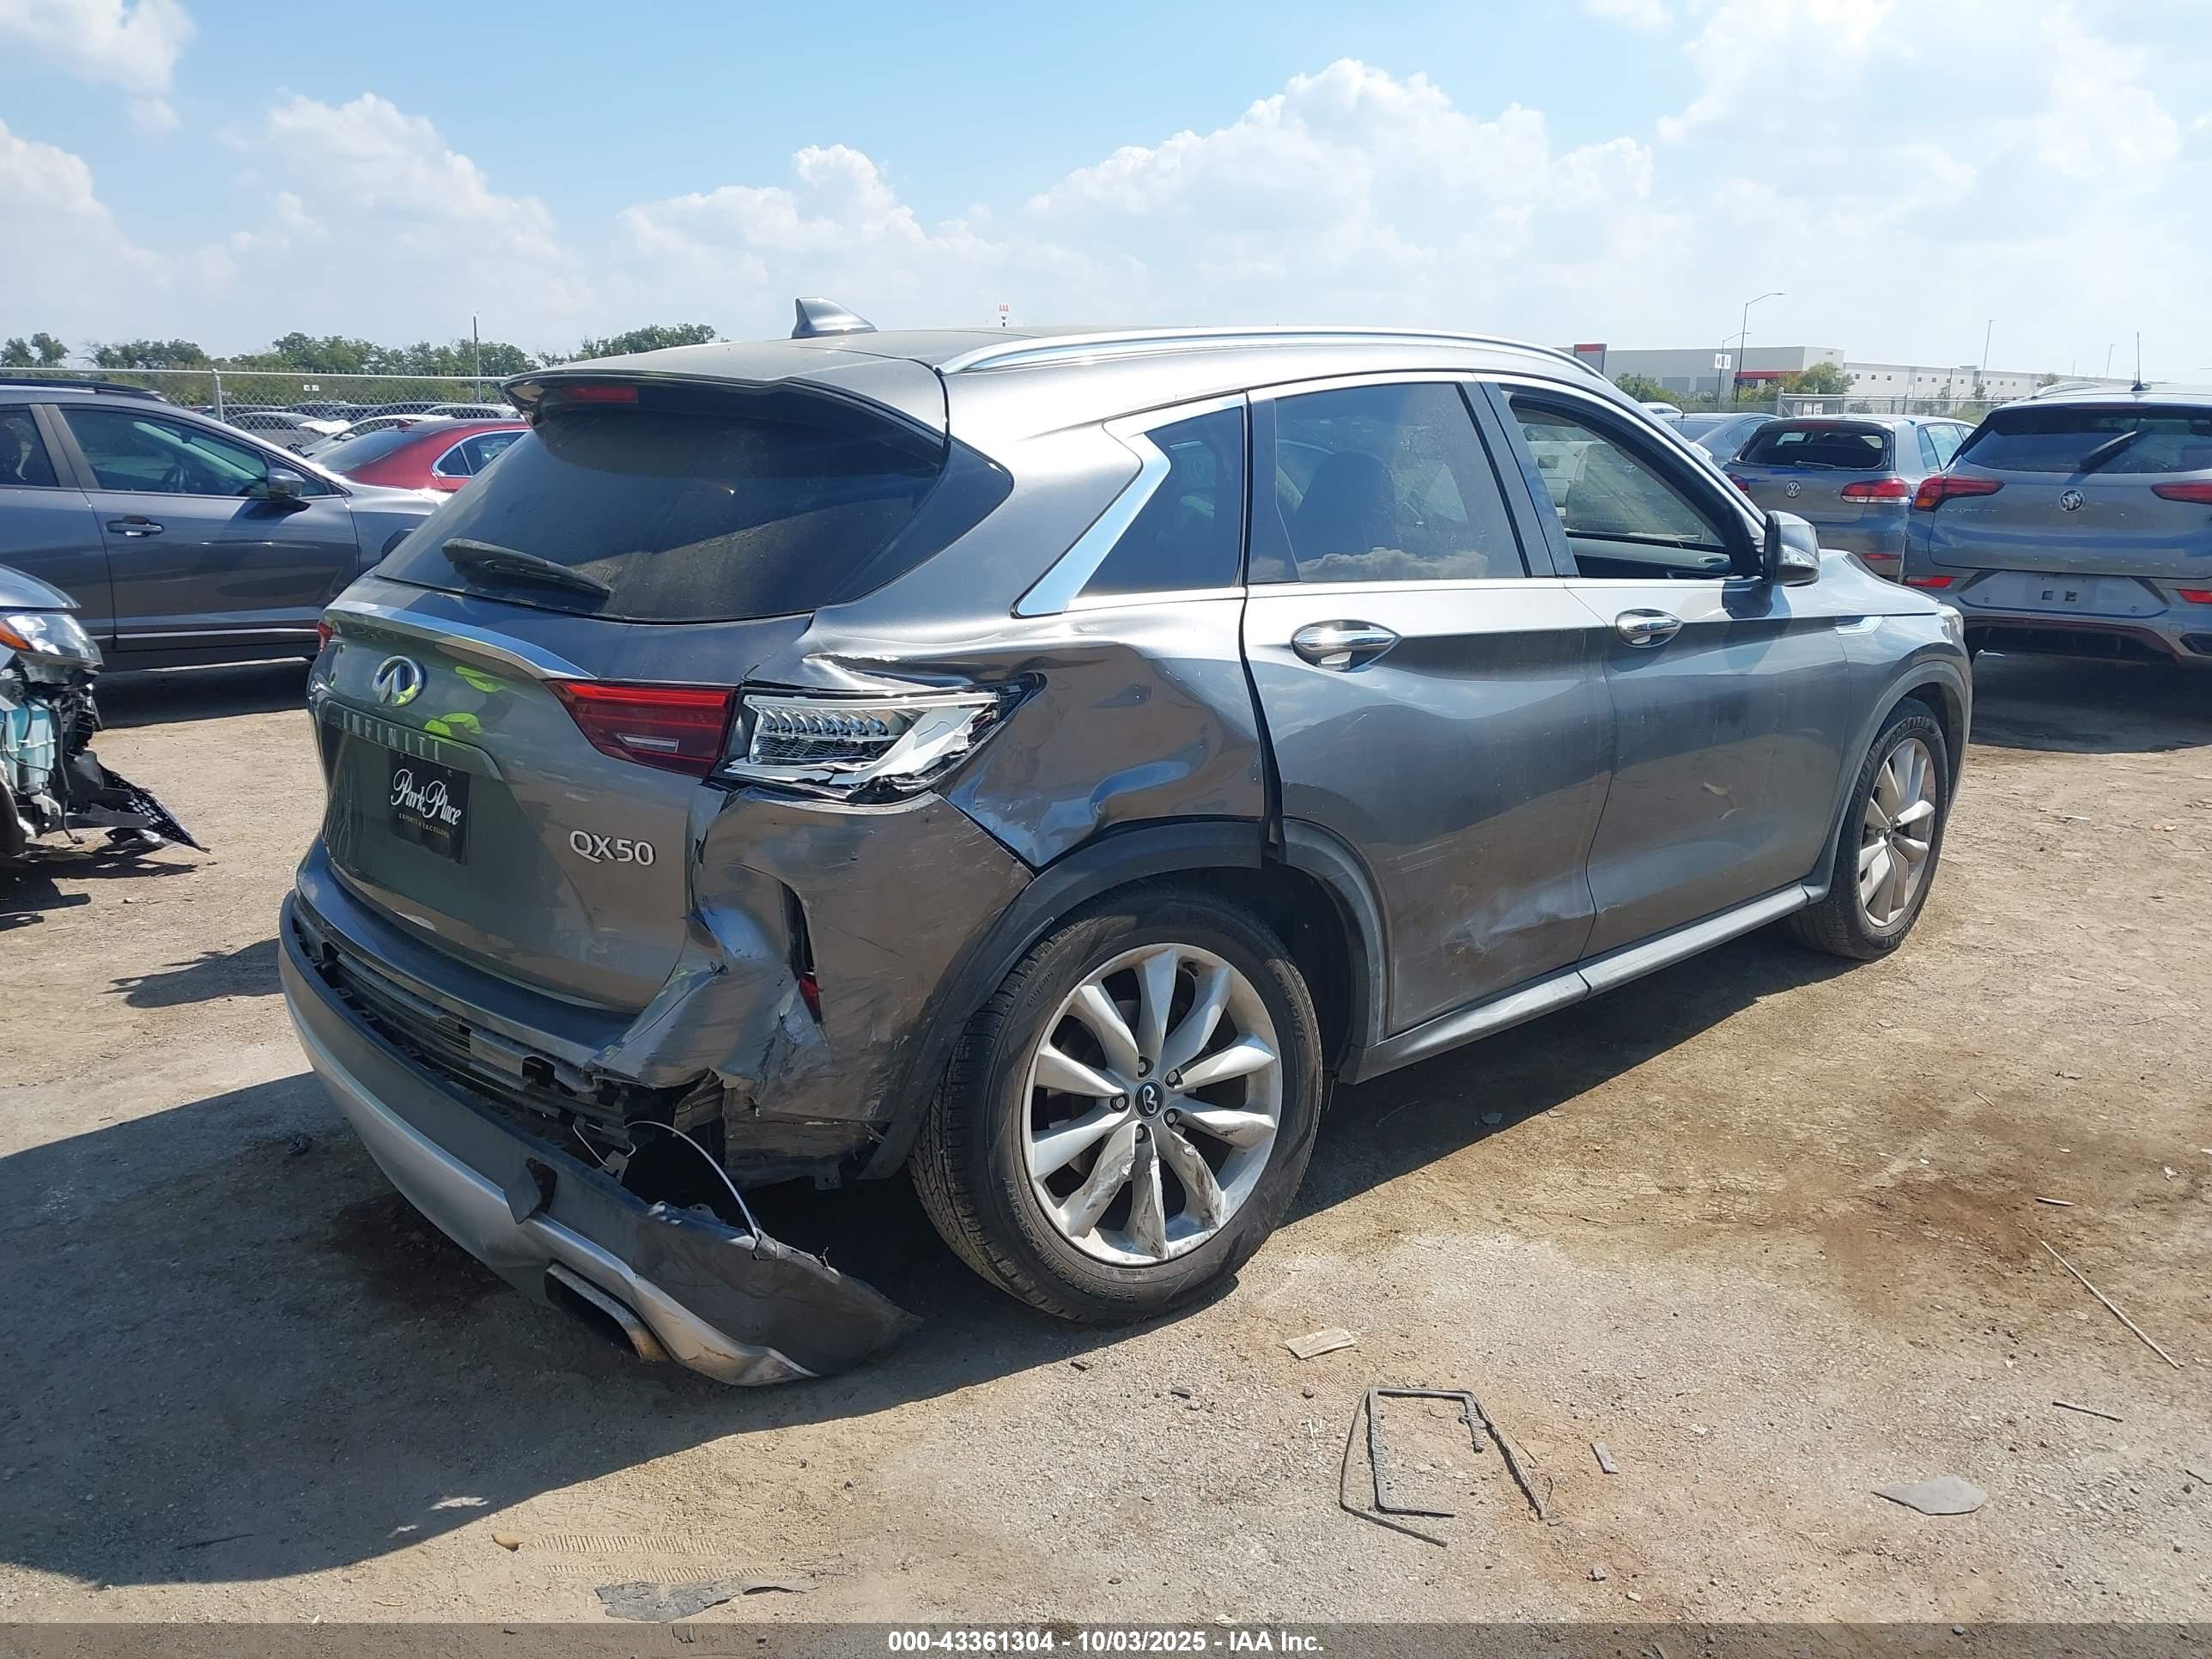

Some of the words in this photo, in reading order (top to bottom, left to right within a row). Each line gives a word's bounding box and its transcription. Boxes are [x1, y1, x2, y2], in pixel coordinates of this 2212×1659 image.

[343, 710, 440, 761] INFINITI
[390, 769, 425, 811] Park
[422, 780, 462, 825] Place
[569, 830, 655, 866] QX50
